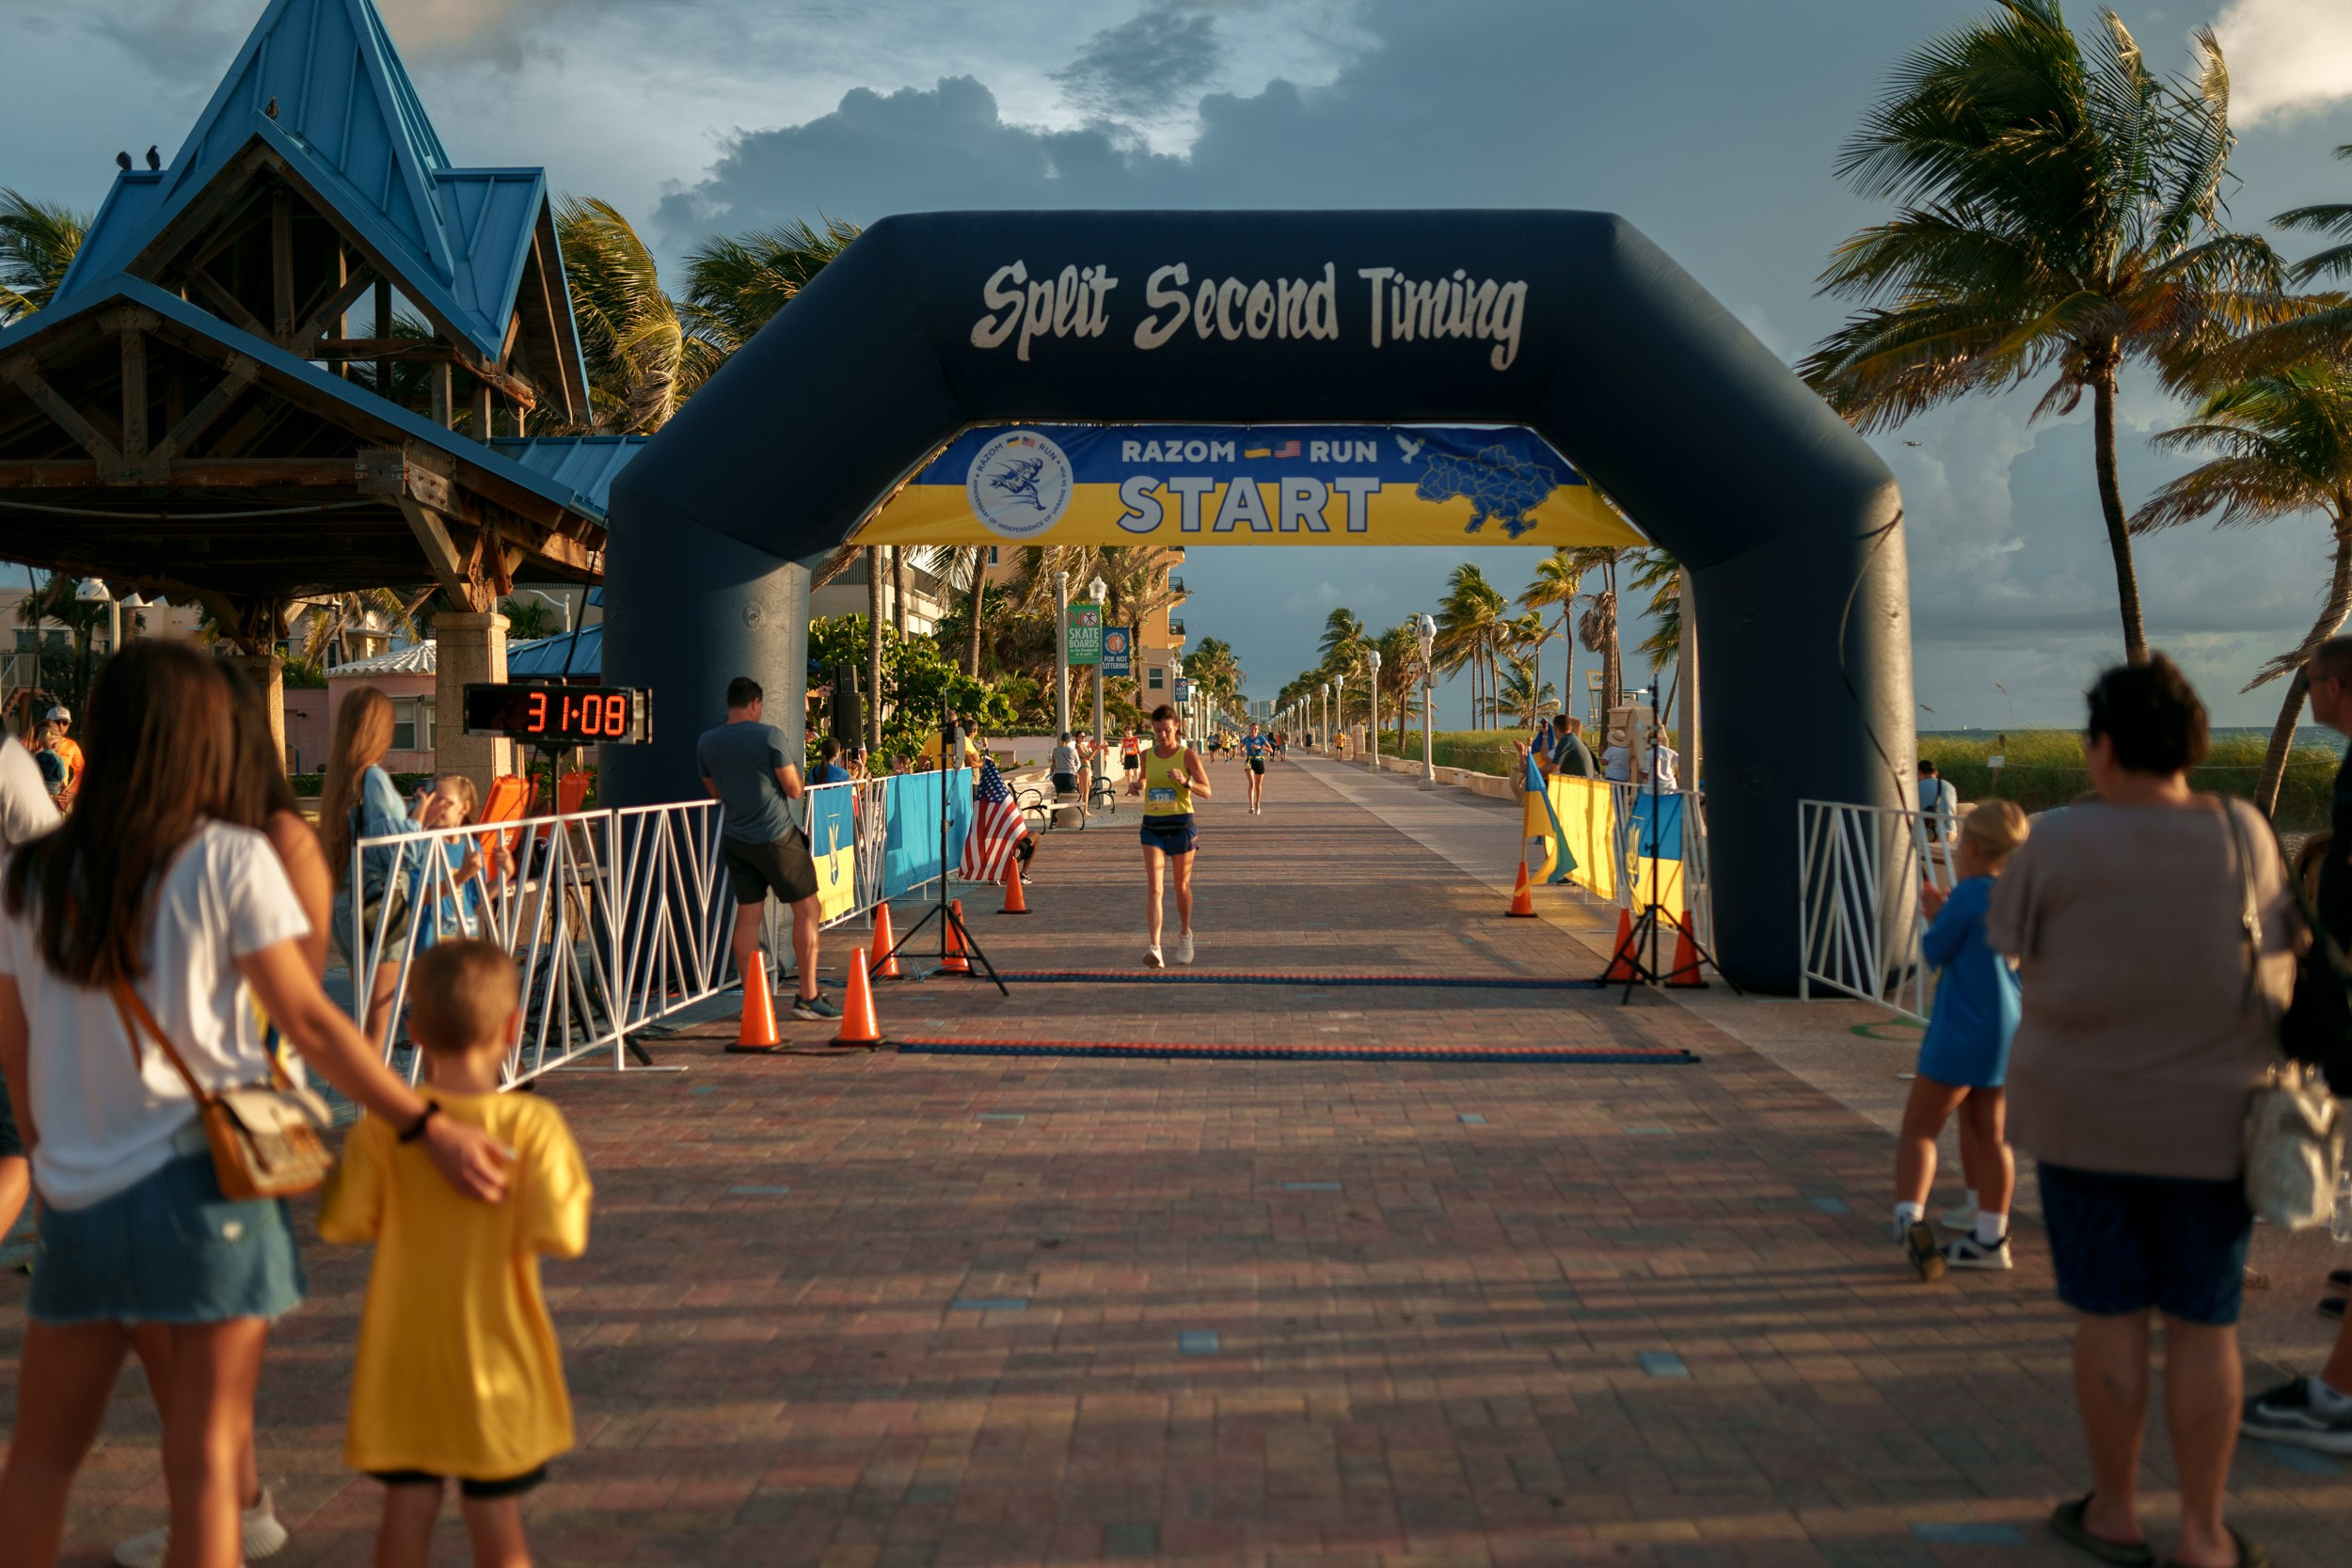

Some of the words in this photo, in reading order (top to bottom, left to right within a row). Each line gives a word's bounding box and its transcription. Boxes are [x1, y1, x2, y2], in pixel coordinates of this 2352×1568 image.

[971, 259, 1119, 361] Split
[1134, 261, 1339, 350] Second
[1358, 267, 1529, 371] Timing
[977, 442, 1004, 472] RAZOM
[1039, 443, 1057, 461] RUN
[1121, 440, 1235, 462] RAZOM
[1310, 440, 1377, 462] RUN
[973, 478, 991, 517] ANNIVERSARY
[989, 516, 997, 525] OF
[998, 521, 1044, 532] INDEPENDENCE
[1043, 514, 1052, 523] OF
[1052, 489, 1066, 515] UKRAINE
[1116, 474, 1382, 533] START
[1069, 610, 1099, 627] NO
[1069, 627, 1099, 640] SKATE
[1069, 639, 1099, 648] BOARDS
[1155, 793, 1170, 804] 178
